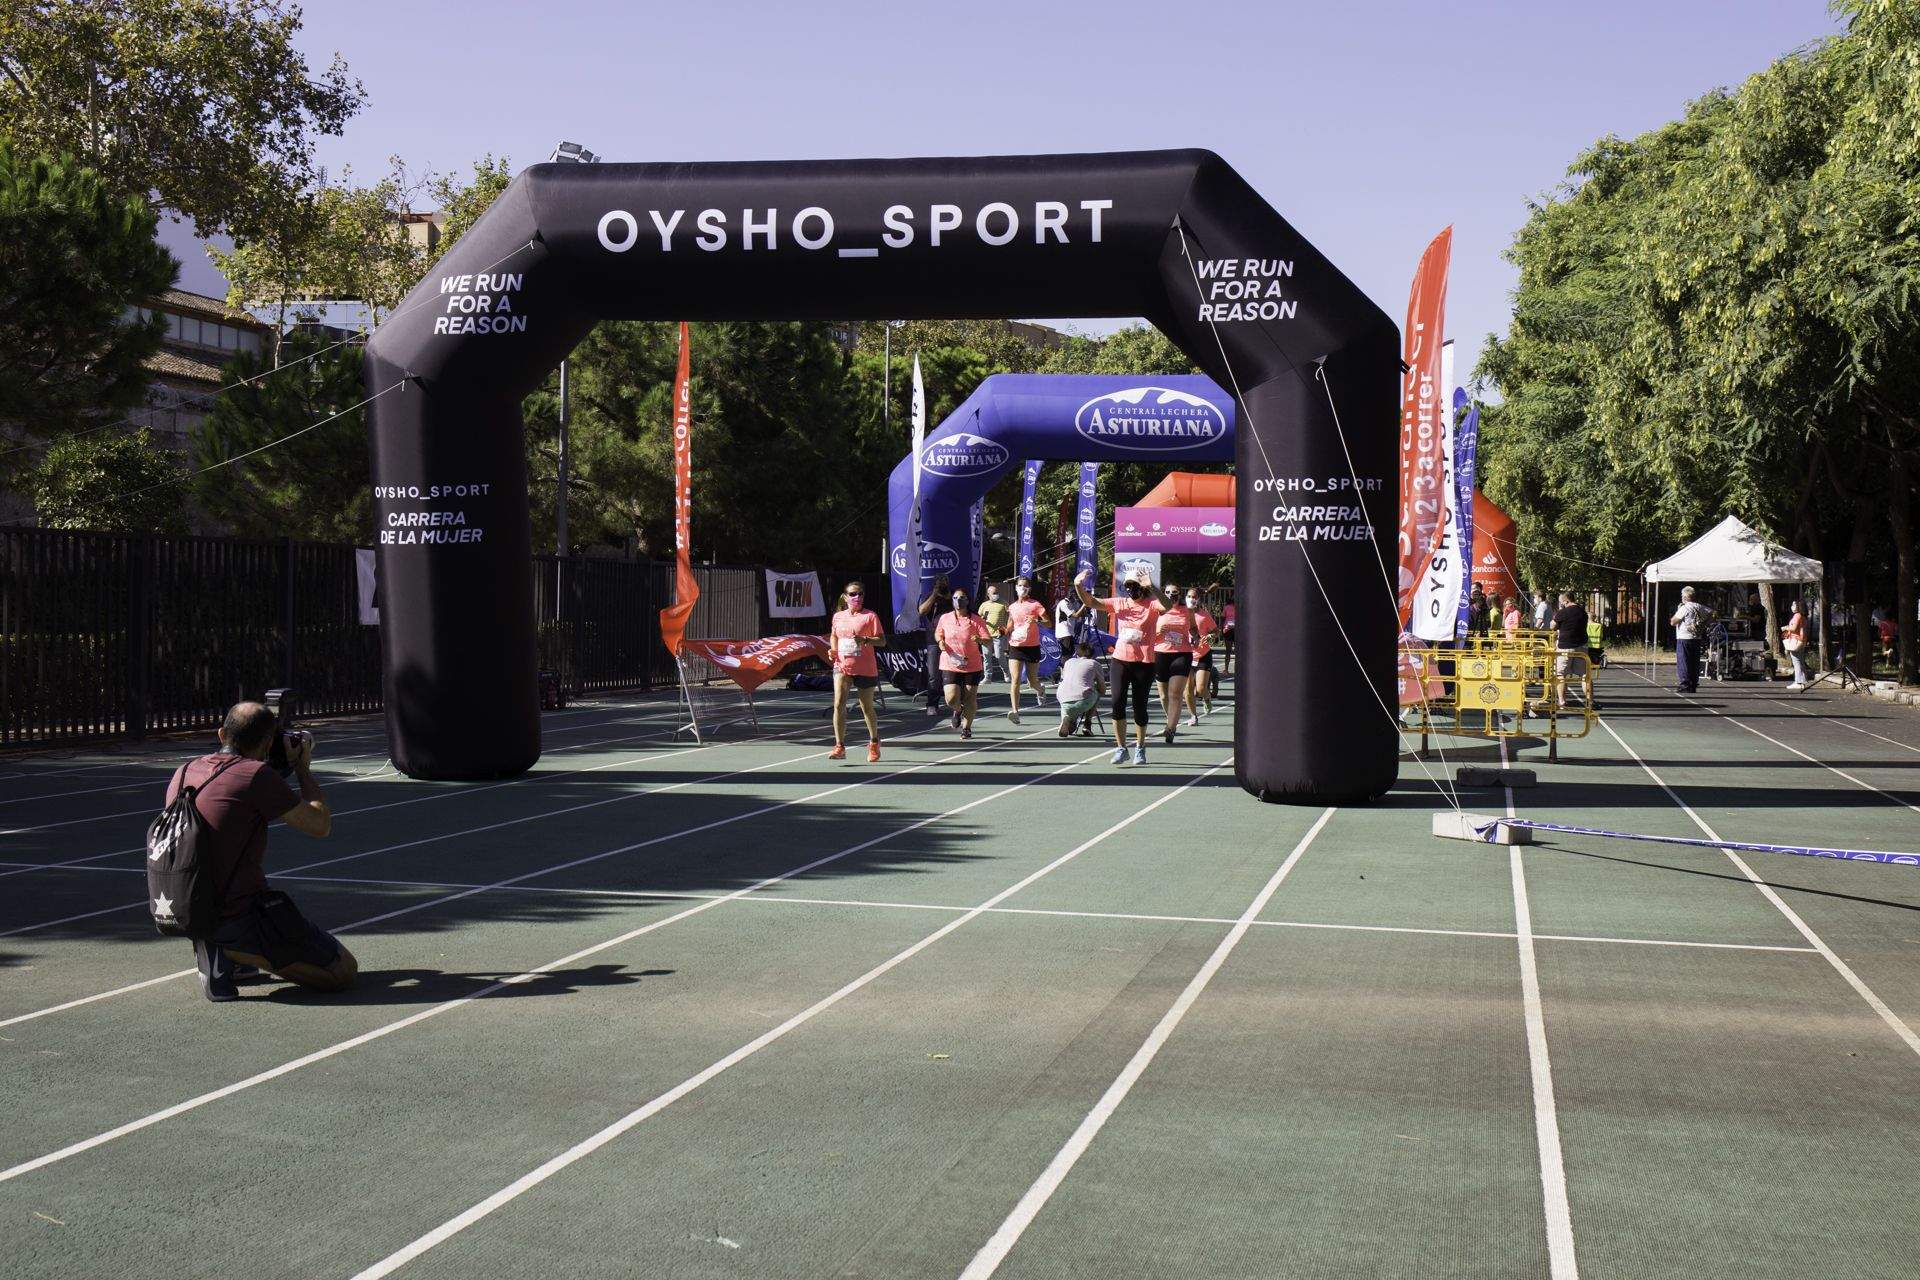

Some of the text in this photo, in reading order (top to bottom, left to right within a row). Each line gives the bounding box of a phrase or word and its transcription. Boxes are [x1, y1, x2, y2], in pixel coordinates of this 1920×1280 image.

[597, 199, 1113, 258] OYSHO_SPORT
[1198, 258, 1294, 279] WE RUN
[440, 273, 523, 294] WE RUN
[1210, 279, 1282, 300] FOR A
[446, 294, 512, 314] FOR A
[1198, 300, 1298, 322] REASON
[433, 315, 527, 335] REASON
[1109, 407, 1209, 416] CENTRAL LECHERA
[1087, 408, 1215, 437] ASTURIANA
[924, 449, 1002, 467] ASTURIANA
[375, 483, 490, 500] OYSHO_SPORT
[1254, 477, 1383, 493] OYSHO_SPORT
[388, 511, 466, 527] CARRERA
[1272, 506, 1361, 522] CARRERA
[380, 528, 483, 545] DE LA MUJER
[1258, 526, 1376, 541] DE LA MUJER
[894, 553, 955, 569] ASRIANA
